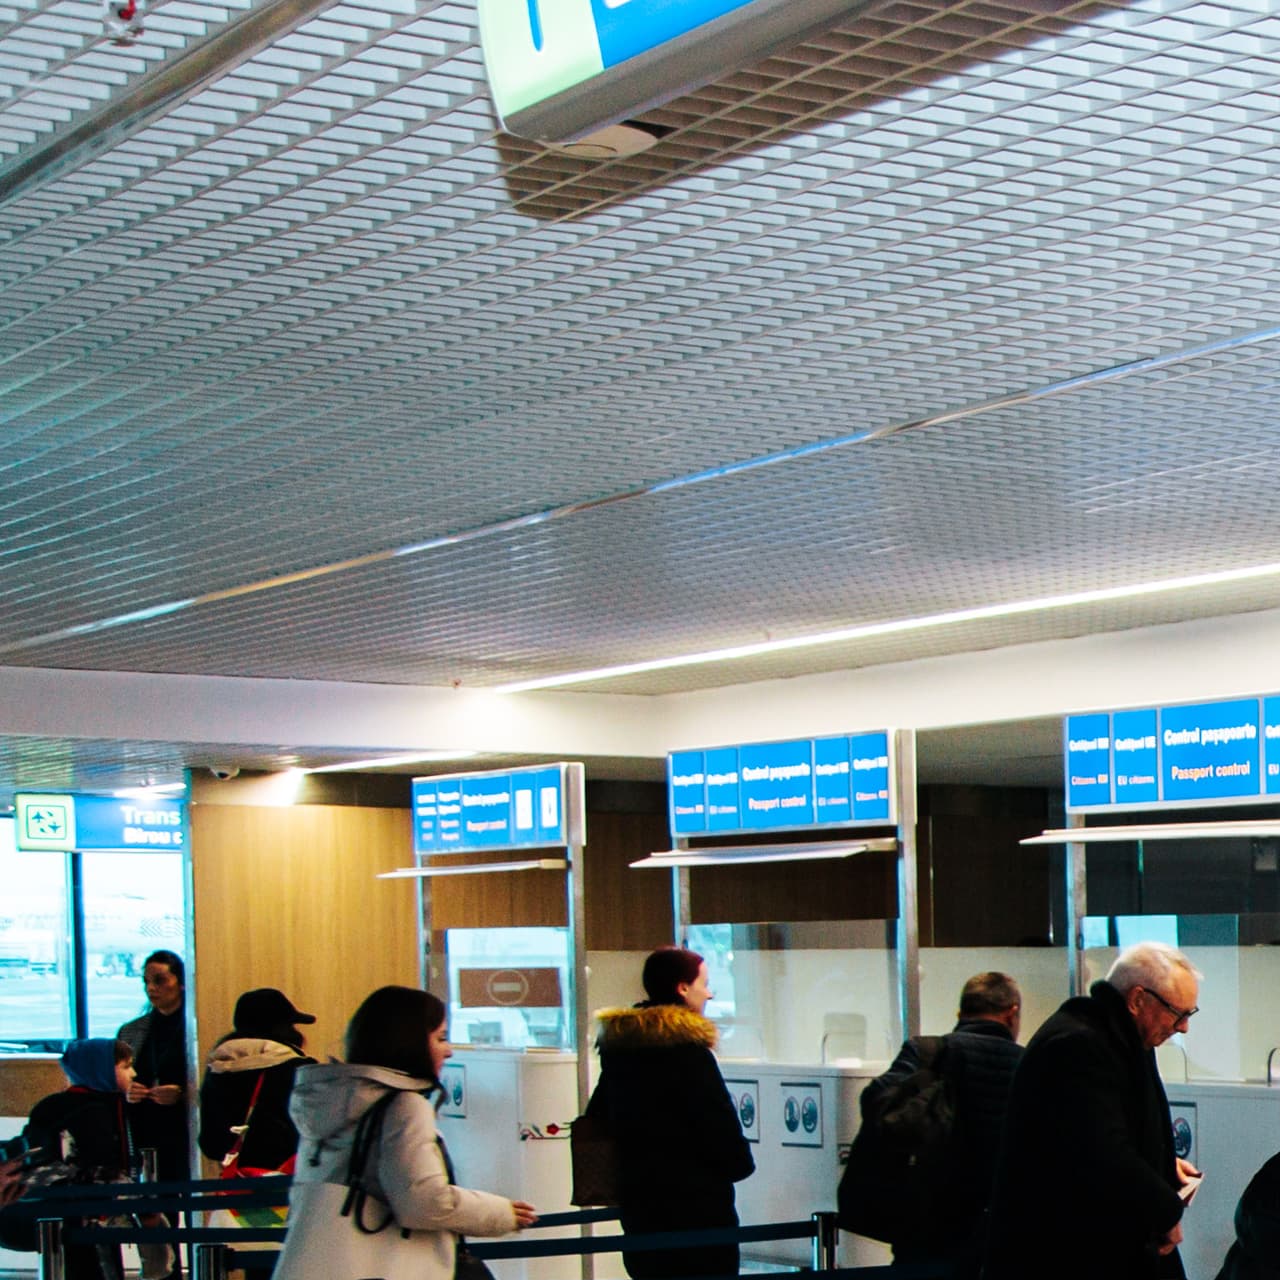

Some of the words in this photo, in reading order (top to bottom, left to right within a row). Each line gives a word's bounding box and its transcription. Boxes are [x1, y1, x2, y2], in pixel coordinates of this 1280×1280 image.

[1172, 765, 1213, 781] Passport
[1216, 761, 1250, 776] control
[120, 805, 182, 826] Trans
